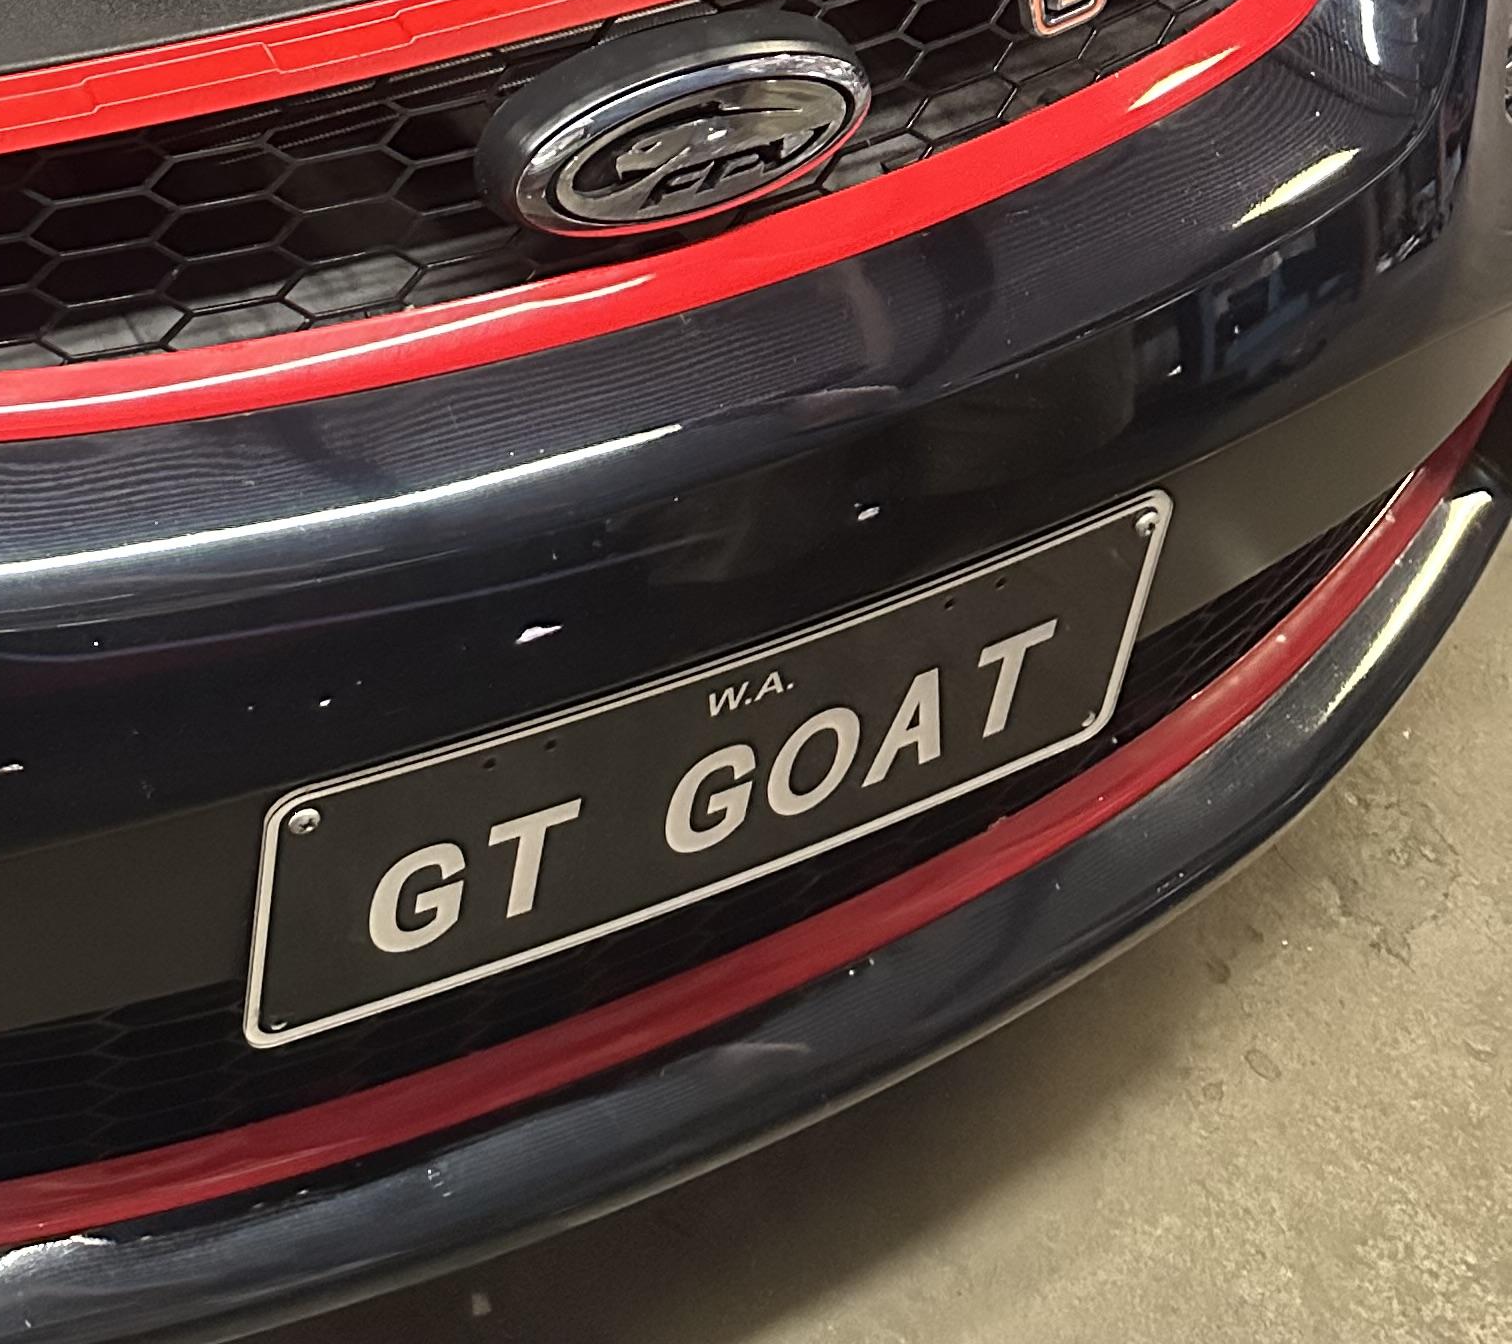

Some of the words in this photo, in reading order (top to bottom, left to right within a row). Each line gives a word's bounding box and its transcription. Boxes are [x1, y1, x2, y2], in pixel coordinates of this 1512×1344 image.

[367, 798, 583, 955] GT
[663, 619, 1058, 856] GOAT
[707, 671, 797, 719] W.A.
